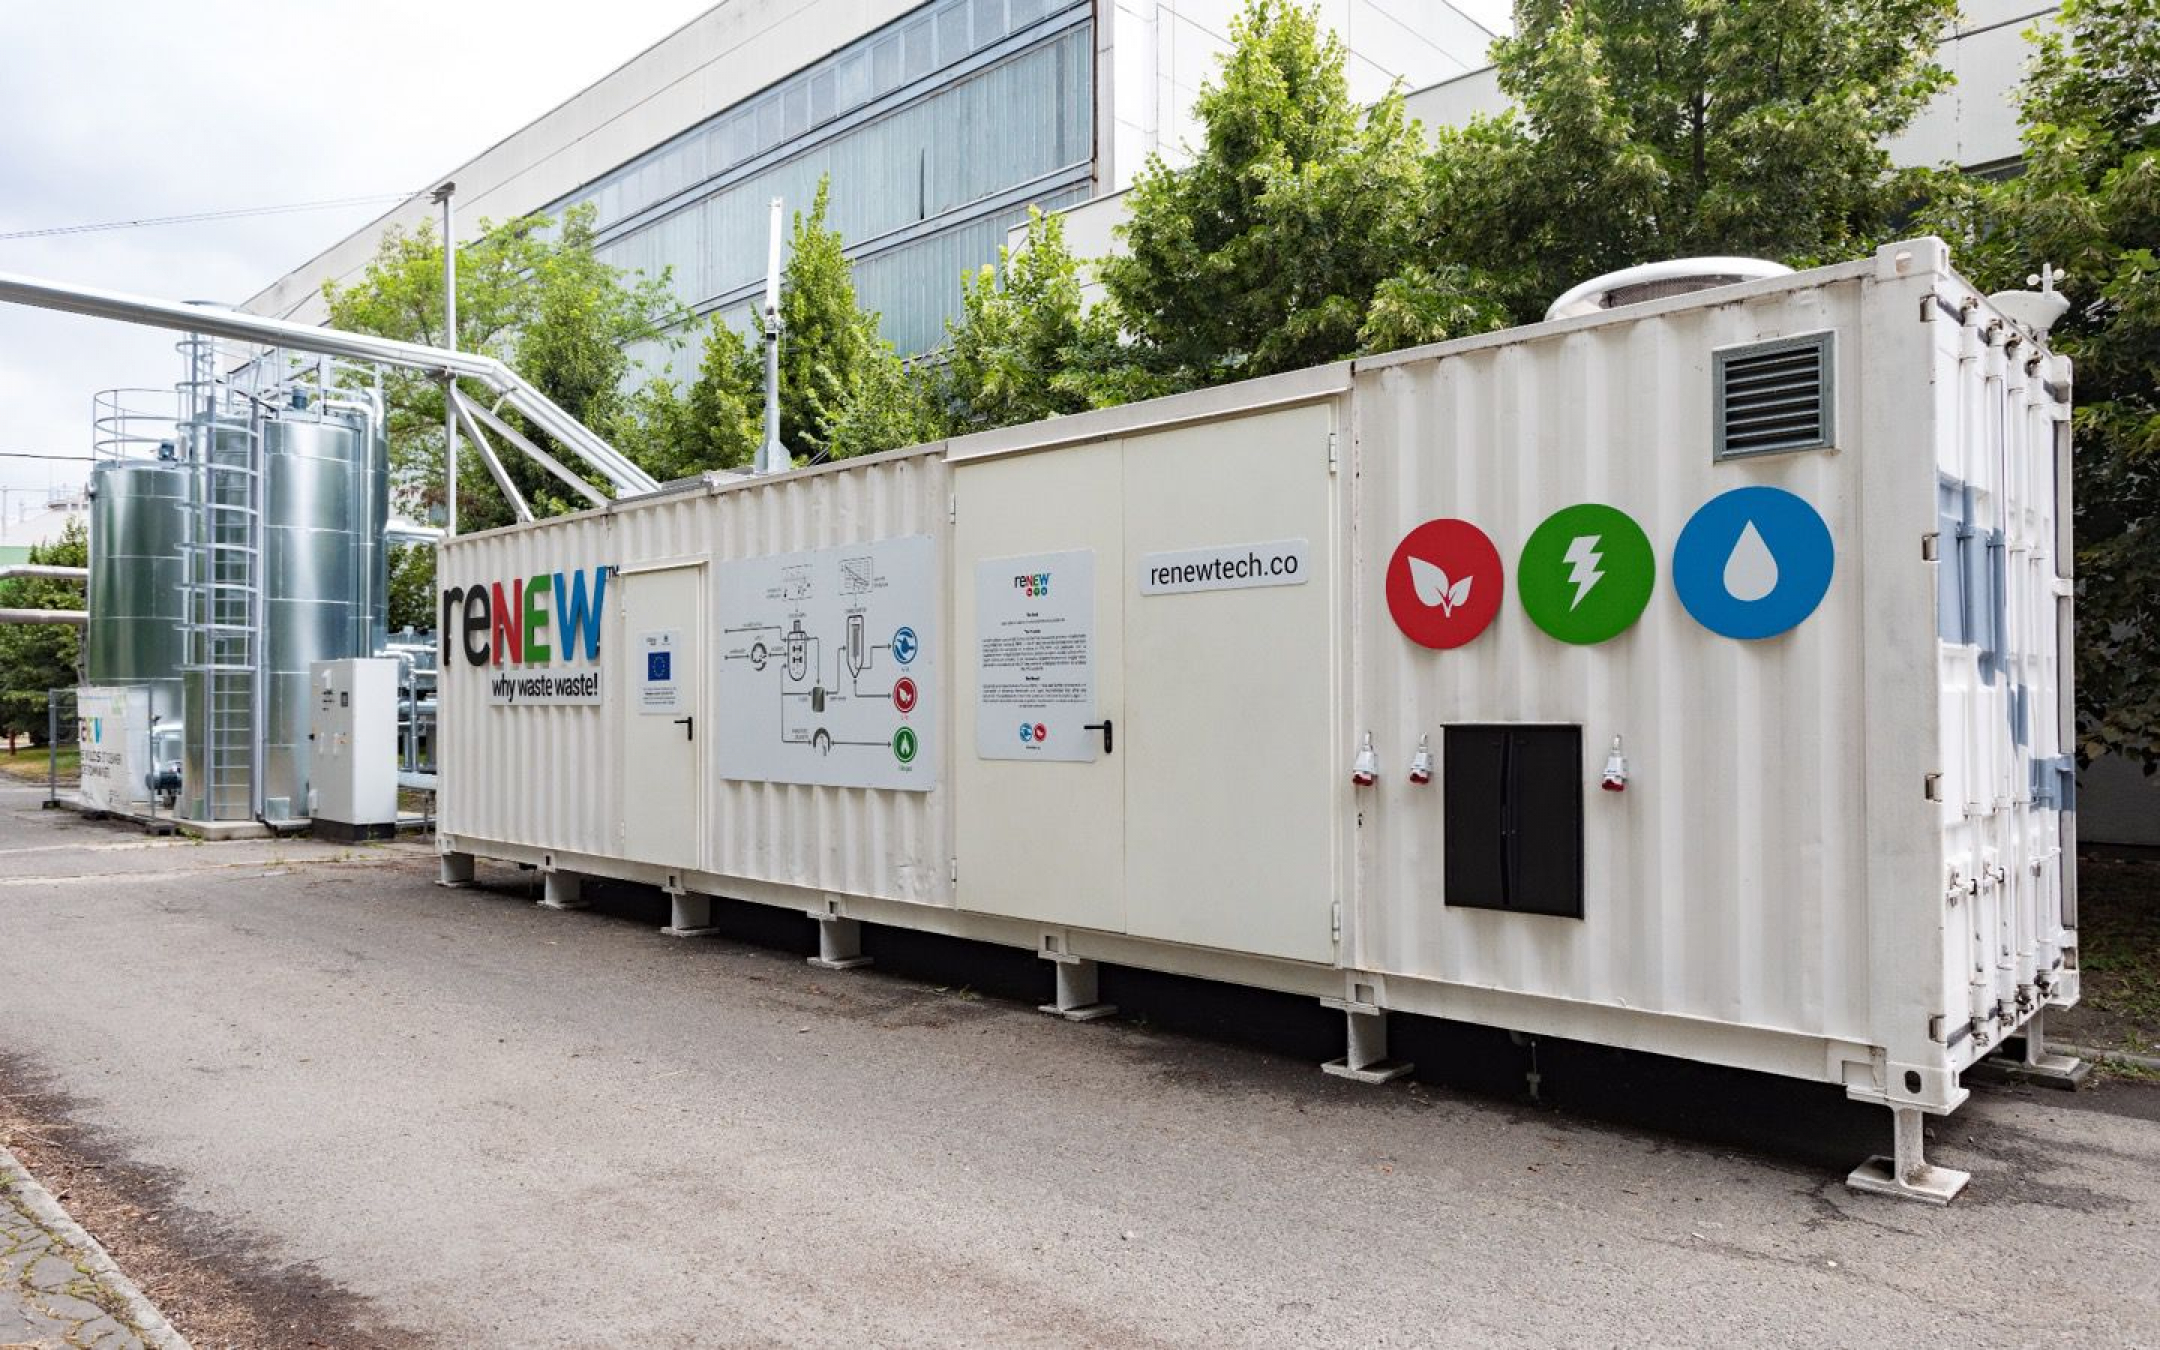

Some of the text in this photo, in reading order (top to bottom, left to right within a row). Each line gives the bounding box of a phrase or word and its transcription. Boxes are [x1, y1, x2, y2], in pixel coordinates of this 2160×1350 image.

[1014, 573, 1050, 589] reNEW
[1150, 551, 1299, 586] renewtech.co
[444, 566, 607, 667] reNEW
[321, 669, 333, 689] 1
[492, 672, 598, 702] why waste waste!
